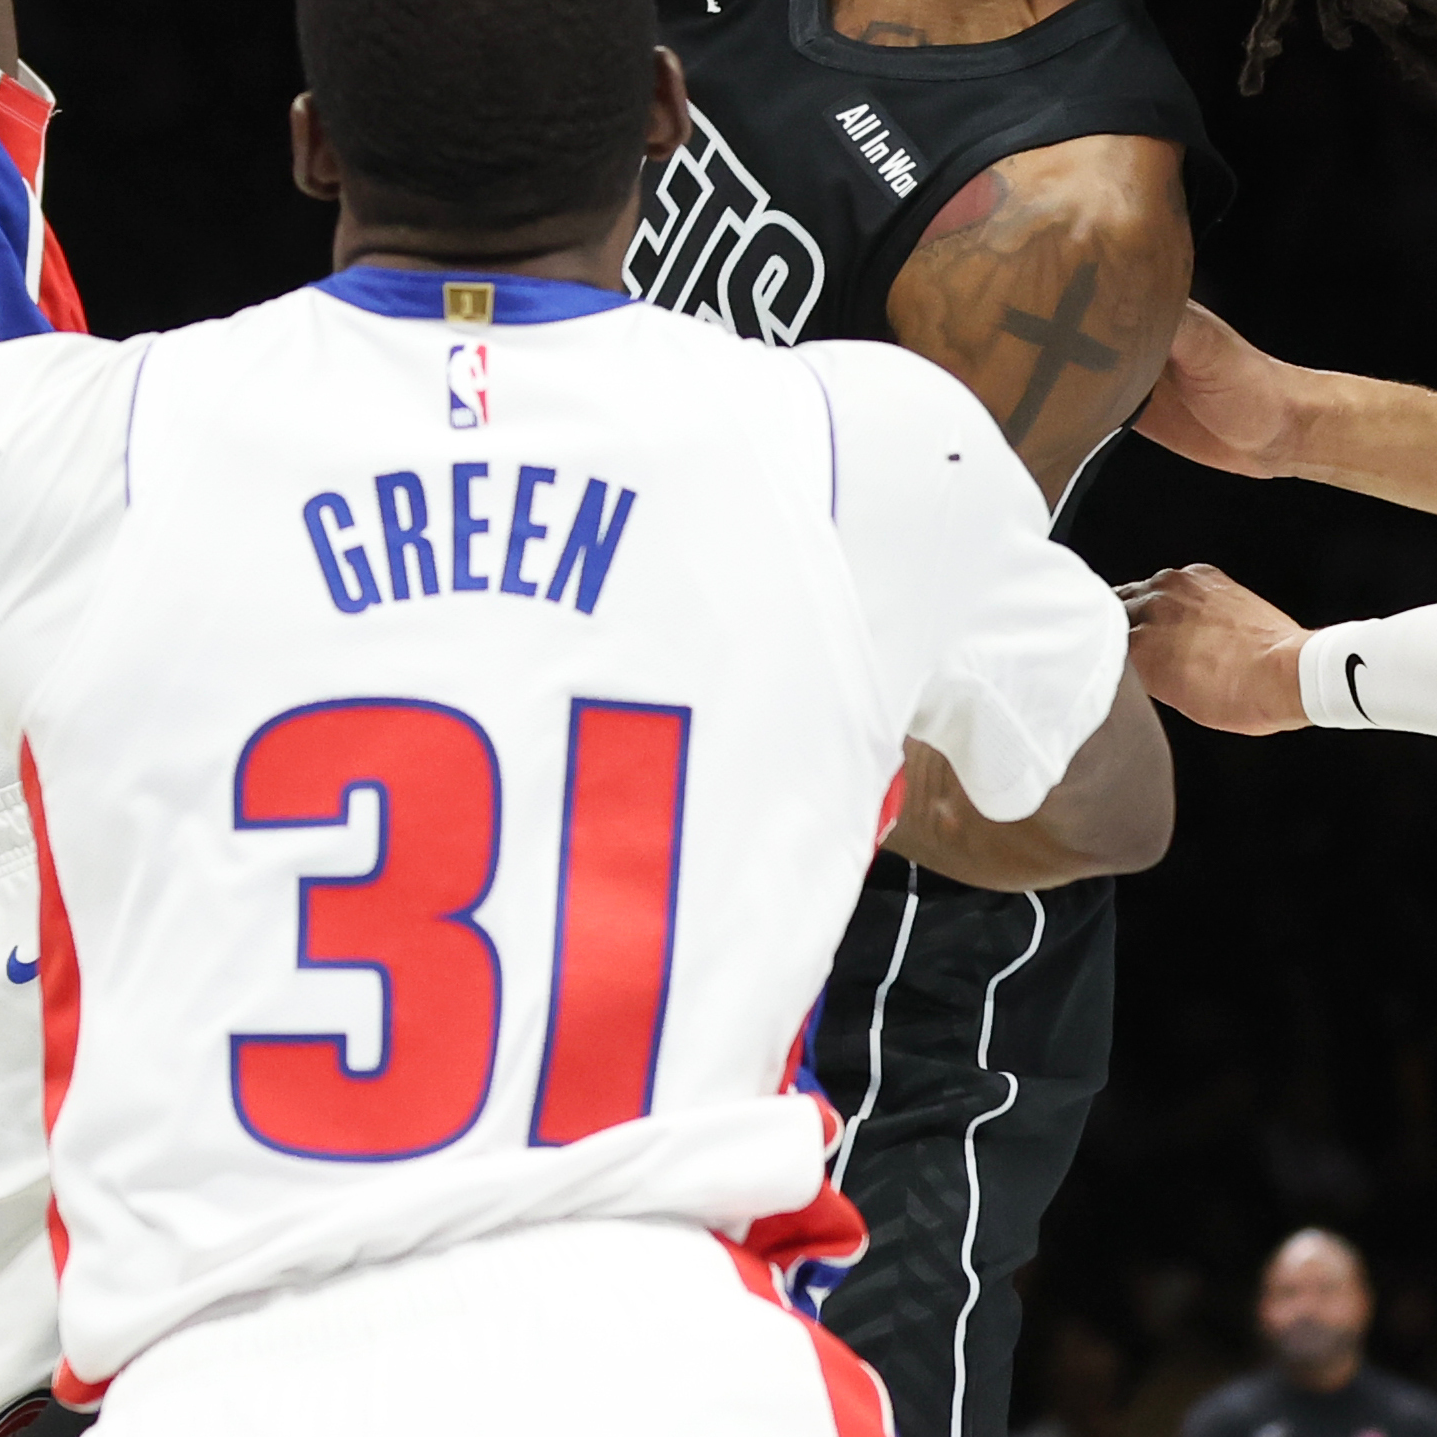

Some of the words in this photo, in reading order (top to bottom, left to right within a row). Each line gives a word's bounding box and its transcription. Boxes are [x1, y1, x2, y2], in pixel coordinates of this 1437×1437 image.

[835, 103, 882, 142] All
[859, 129, 890, 164] In
[303, 460, 638, 618] GREEN
[229, 696, 693, 1163] 31
